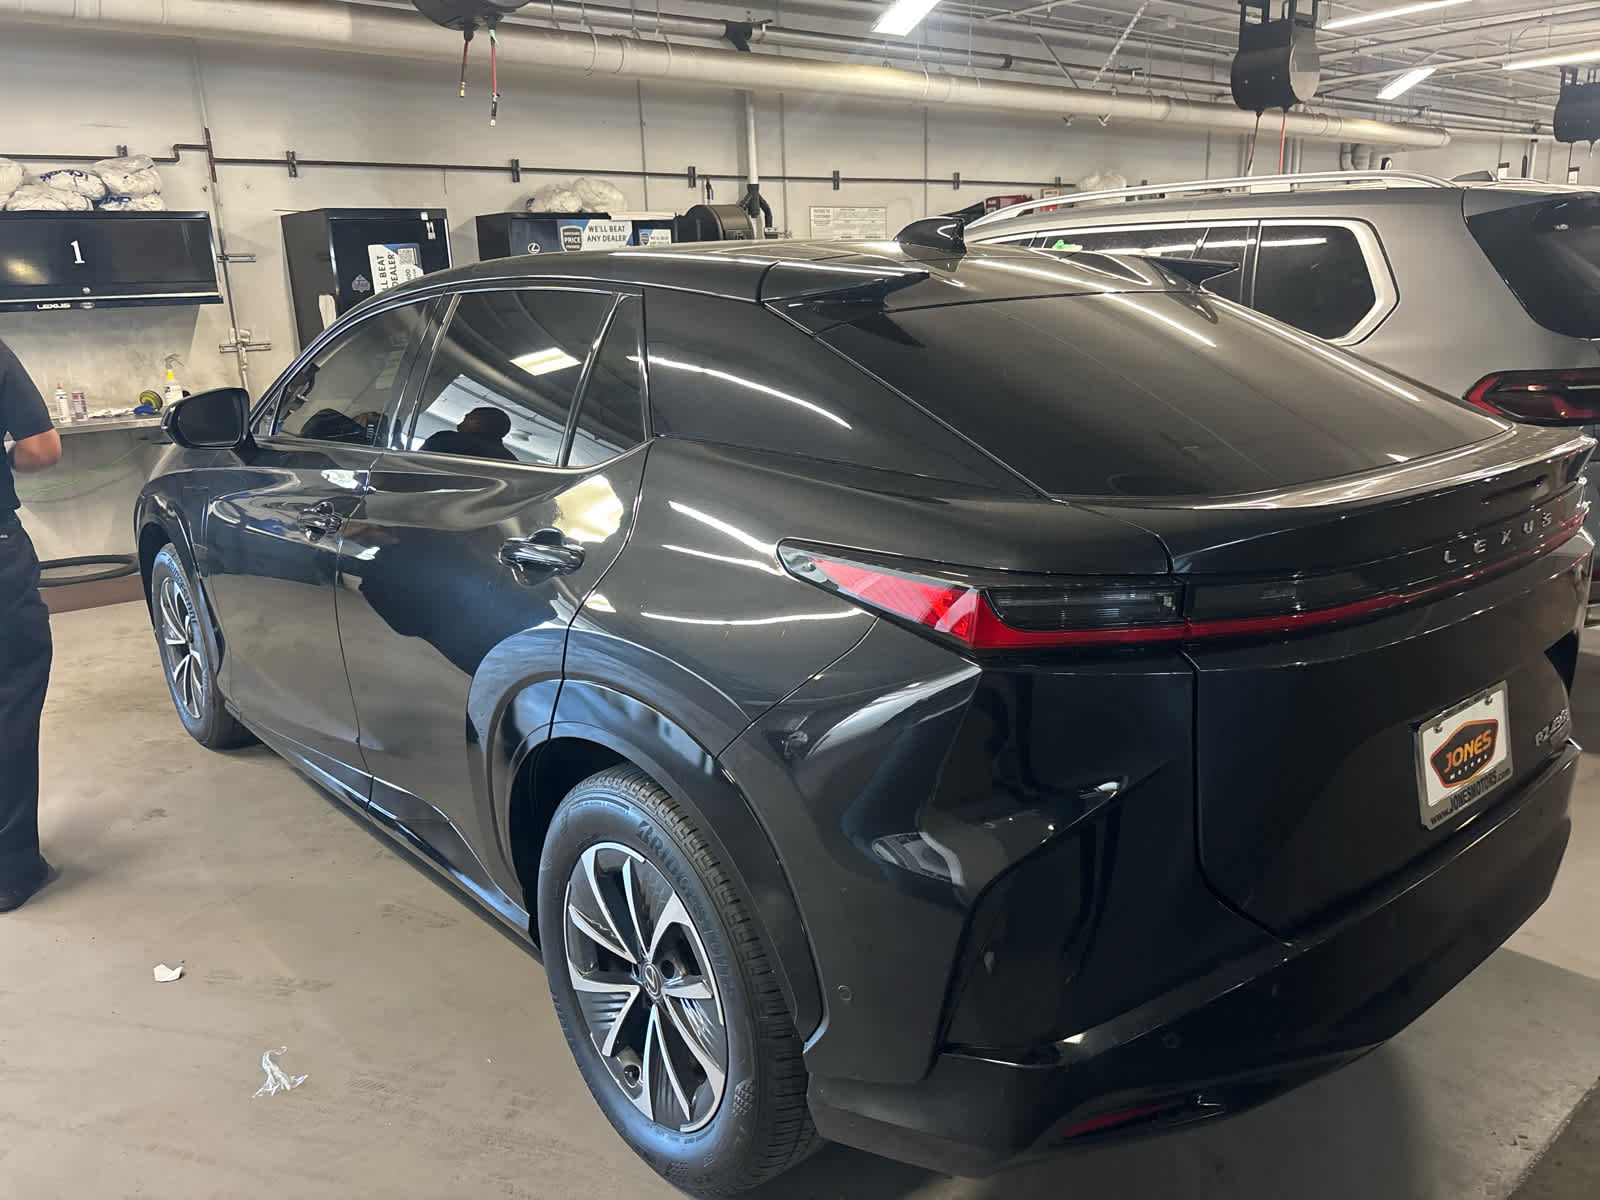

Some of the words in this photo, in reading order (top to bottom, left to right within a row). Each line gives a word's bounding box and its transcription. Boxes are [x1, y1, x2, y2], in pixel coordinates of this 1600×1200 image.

[564, 236, 579, 244] PRICE
[588, 225, 608, 233] WE'LL
[70, 240, 86, 264] 1
[376, 256, 387, 278] BEAT
[1444, 512, 1552, 564] LEXUS
[1444, 729, 1492, 773] JONES
